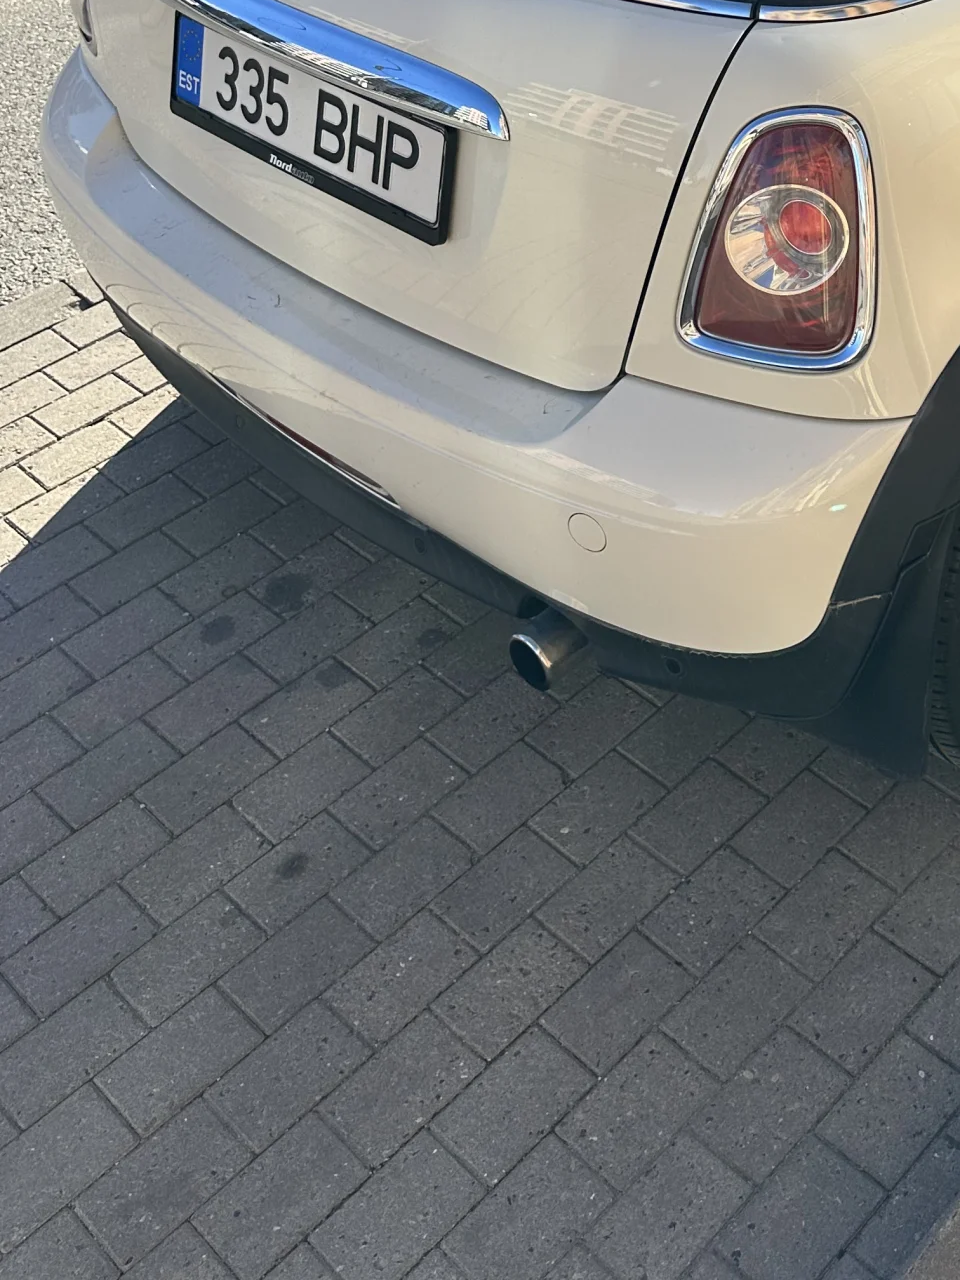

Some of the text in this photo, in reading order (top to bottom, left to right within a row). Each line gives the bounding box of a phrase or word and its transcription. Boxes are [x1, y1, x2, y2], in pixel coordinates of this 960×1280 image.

[179, 70, 200, 94] EST
[216, 46, 419, 191] 335 BHP
